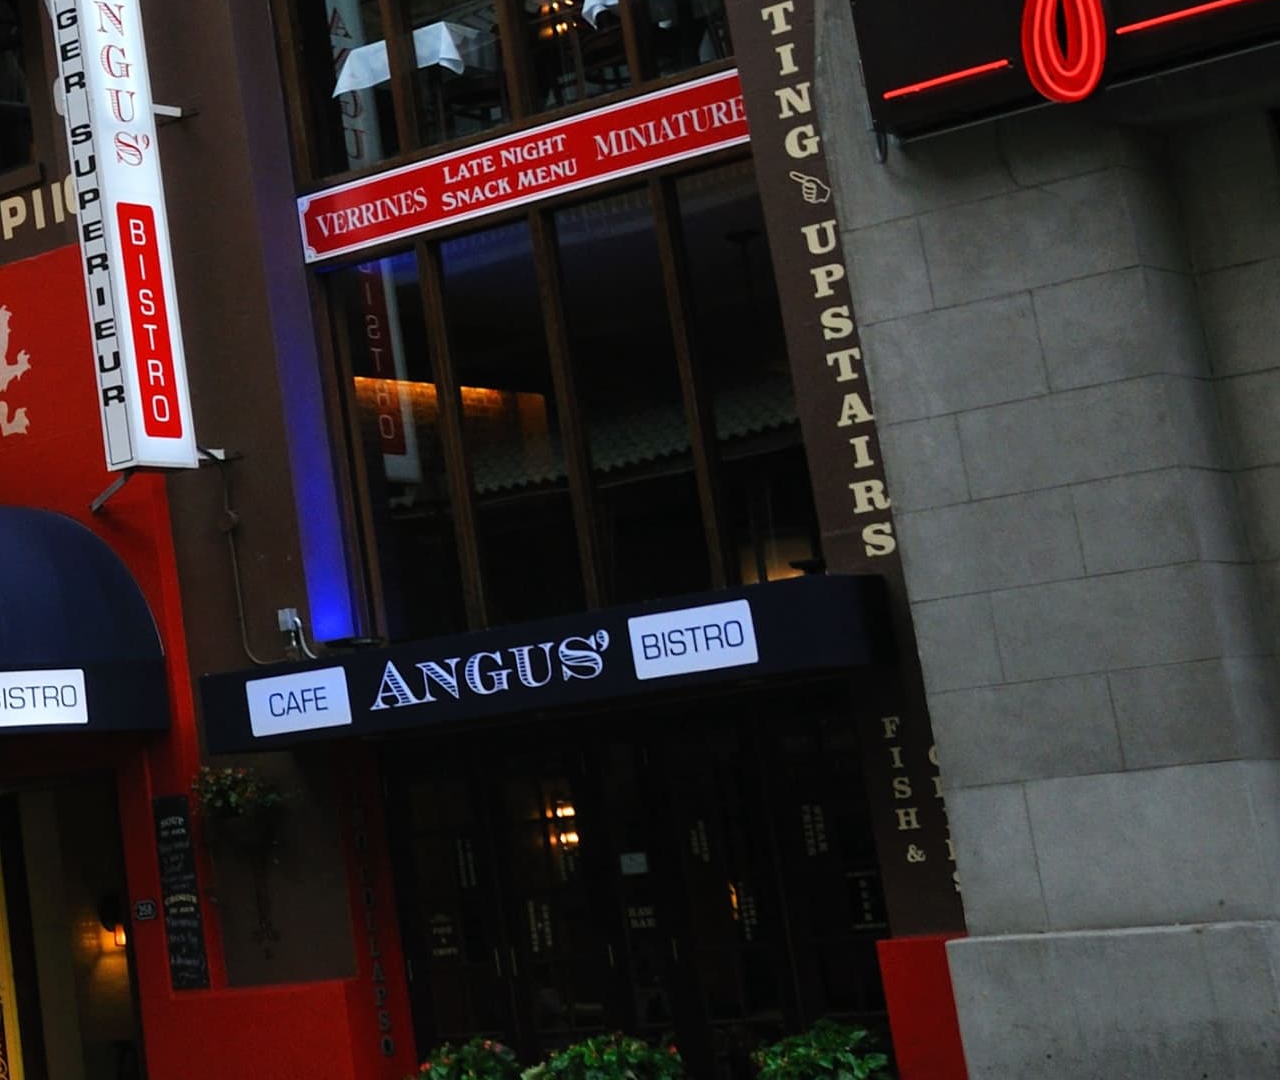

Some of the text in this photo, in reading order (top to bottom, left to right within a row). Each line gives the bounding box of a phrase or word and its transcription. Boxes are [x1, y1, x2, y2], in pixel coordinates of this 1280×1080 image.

[316, 186, 429, 239] VERRINES
[441, 158, 579, 212] SNACK MENU
[442, 133, 568, 185] LATE NIGHT
[70, 123, 126, 408] SUPERIEUR
[128, 218, 171, 423] BISTRO
[801, 219, 897, 558] UPSTAIRS
[268, 619, 745, 718] CAFE ANGUS' BISTRO
[881, 716, 927, 863] FISH &
